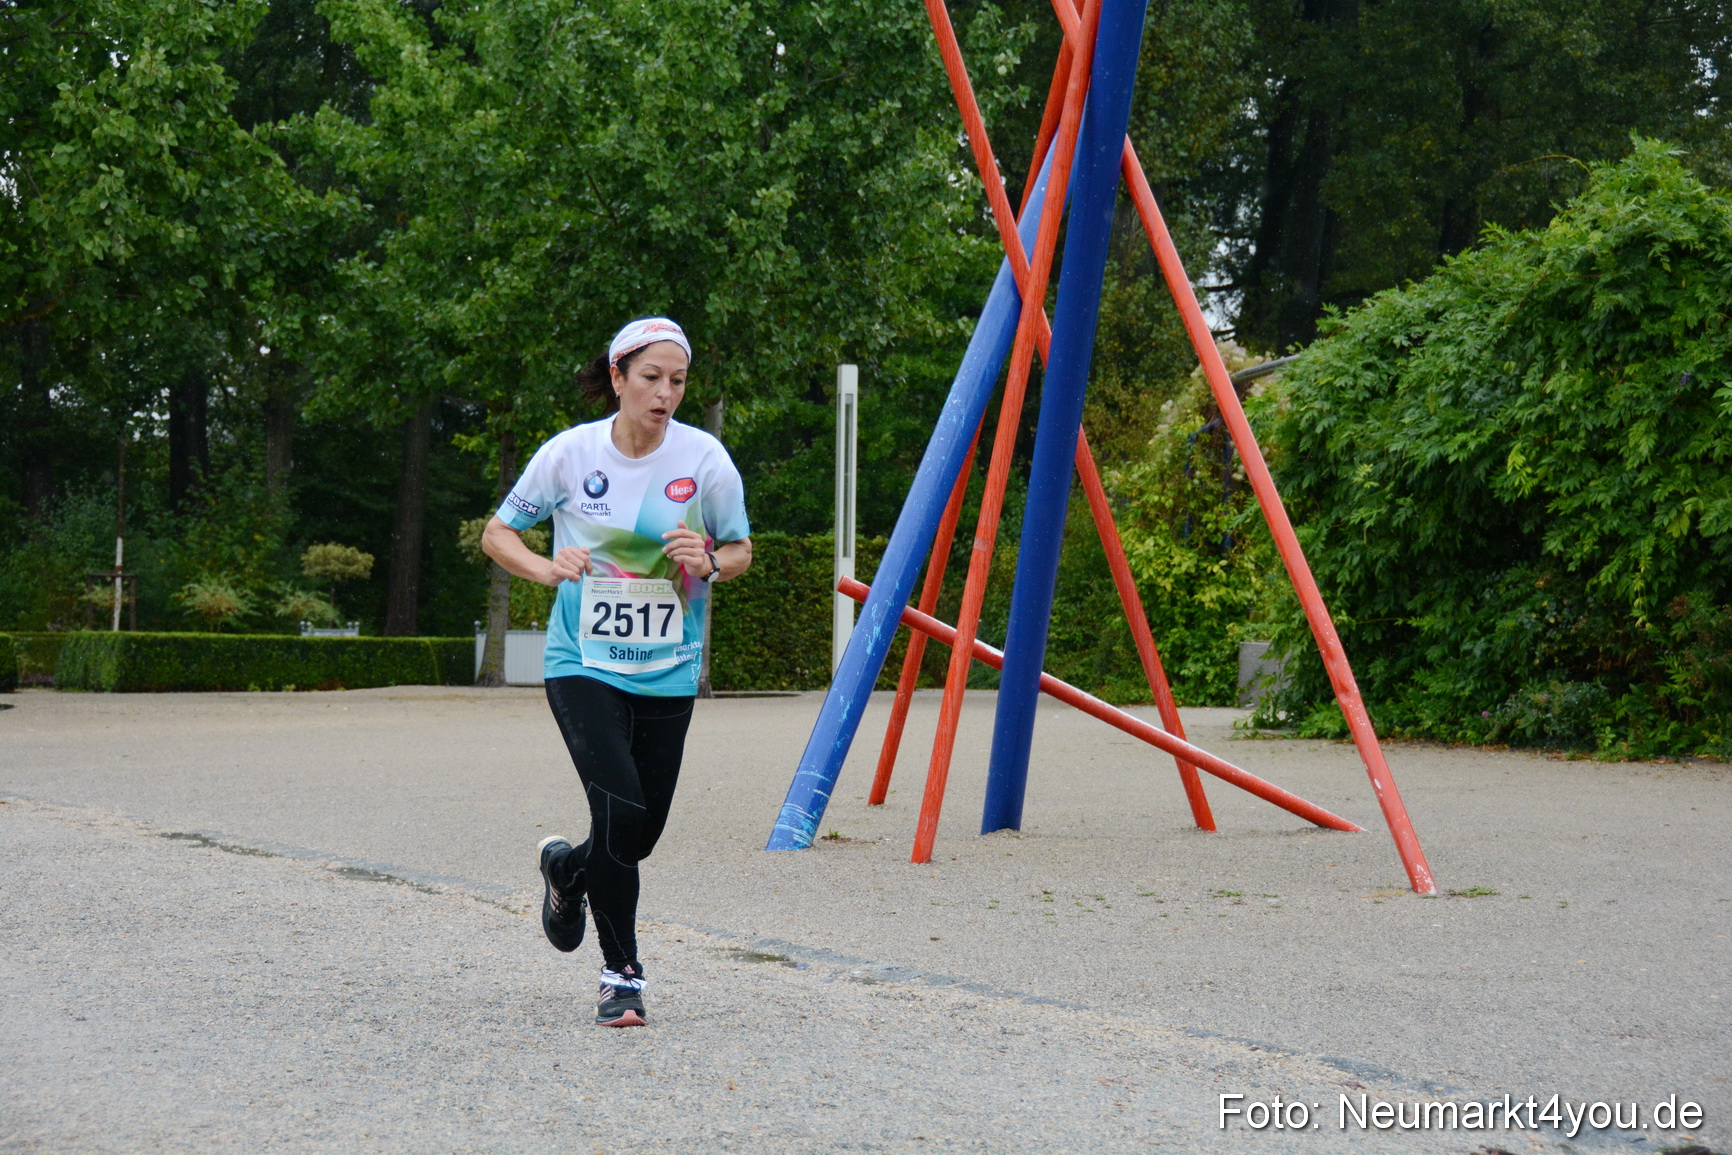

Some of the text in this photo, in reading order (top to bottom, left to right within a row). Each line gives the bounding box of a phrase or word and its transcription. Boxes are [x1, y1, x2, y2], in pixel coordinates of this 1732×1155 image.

[670, 485, 693, 496] Hers
[508, 491, 541, 516] BOCK
[580, 502, 611, 511] PARTL
[629, 582, 674, 594] BOCK
[591, 601, 676, 638] 2517
[609, 646, 654, 661] Sabine
